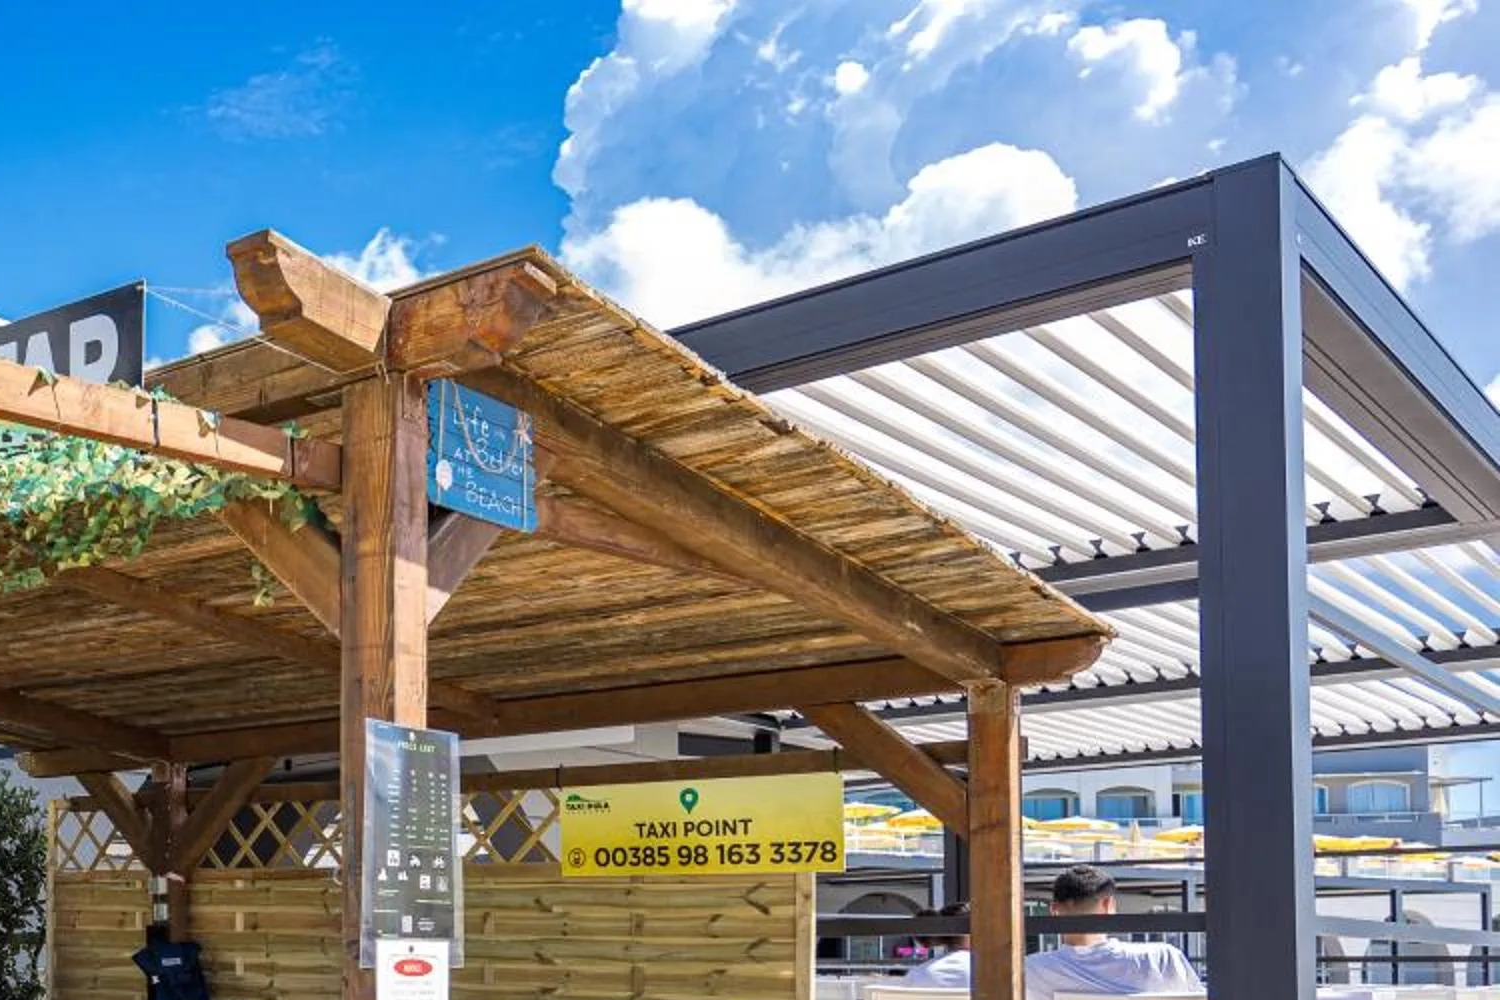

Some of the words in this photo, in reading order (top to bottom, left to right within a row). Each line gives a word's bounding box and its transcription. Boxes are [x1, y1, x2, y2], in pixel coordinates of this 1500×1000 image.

[634, 821, 677, 839] TAXI
[683, 818, 753, 837] POINT
[594, 845, 671, 868] 00385
[677, 844, 709, 867] 98
[715, 842, 761, 865] 163
[769, 840, 837, 864] 3378
